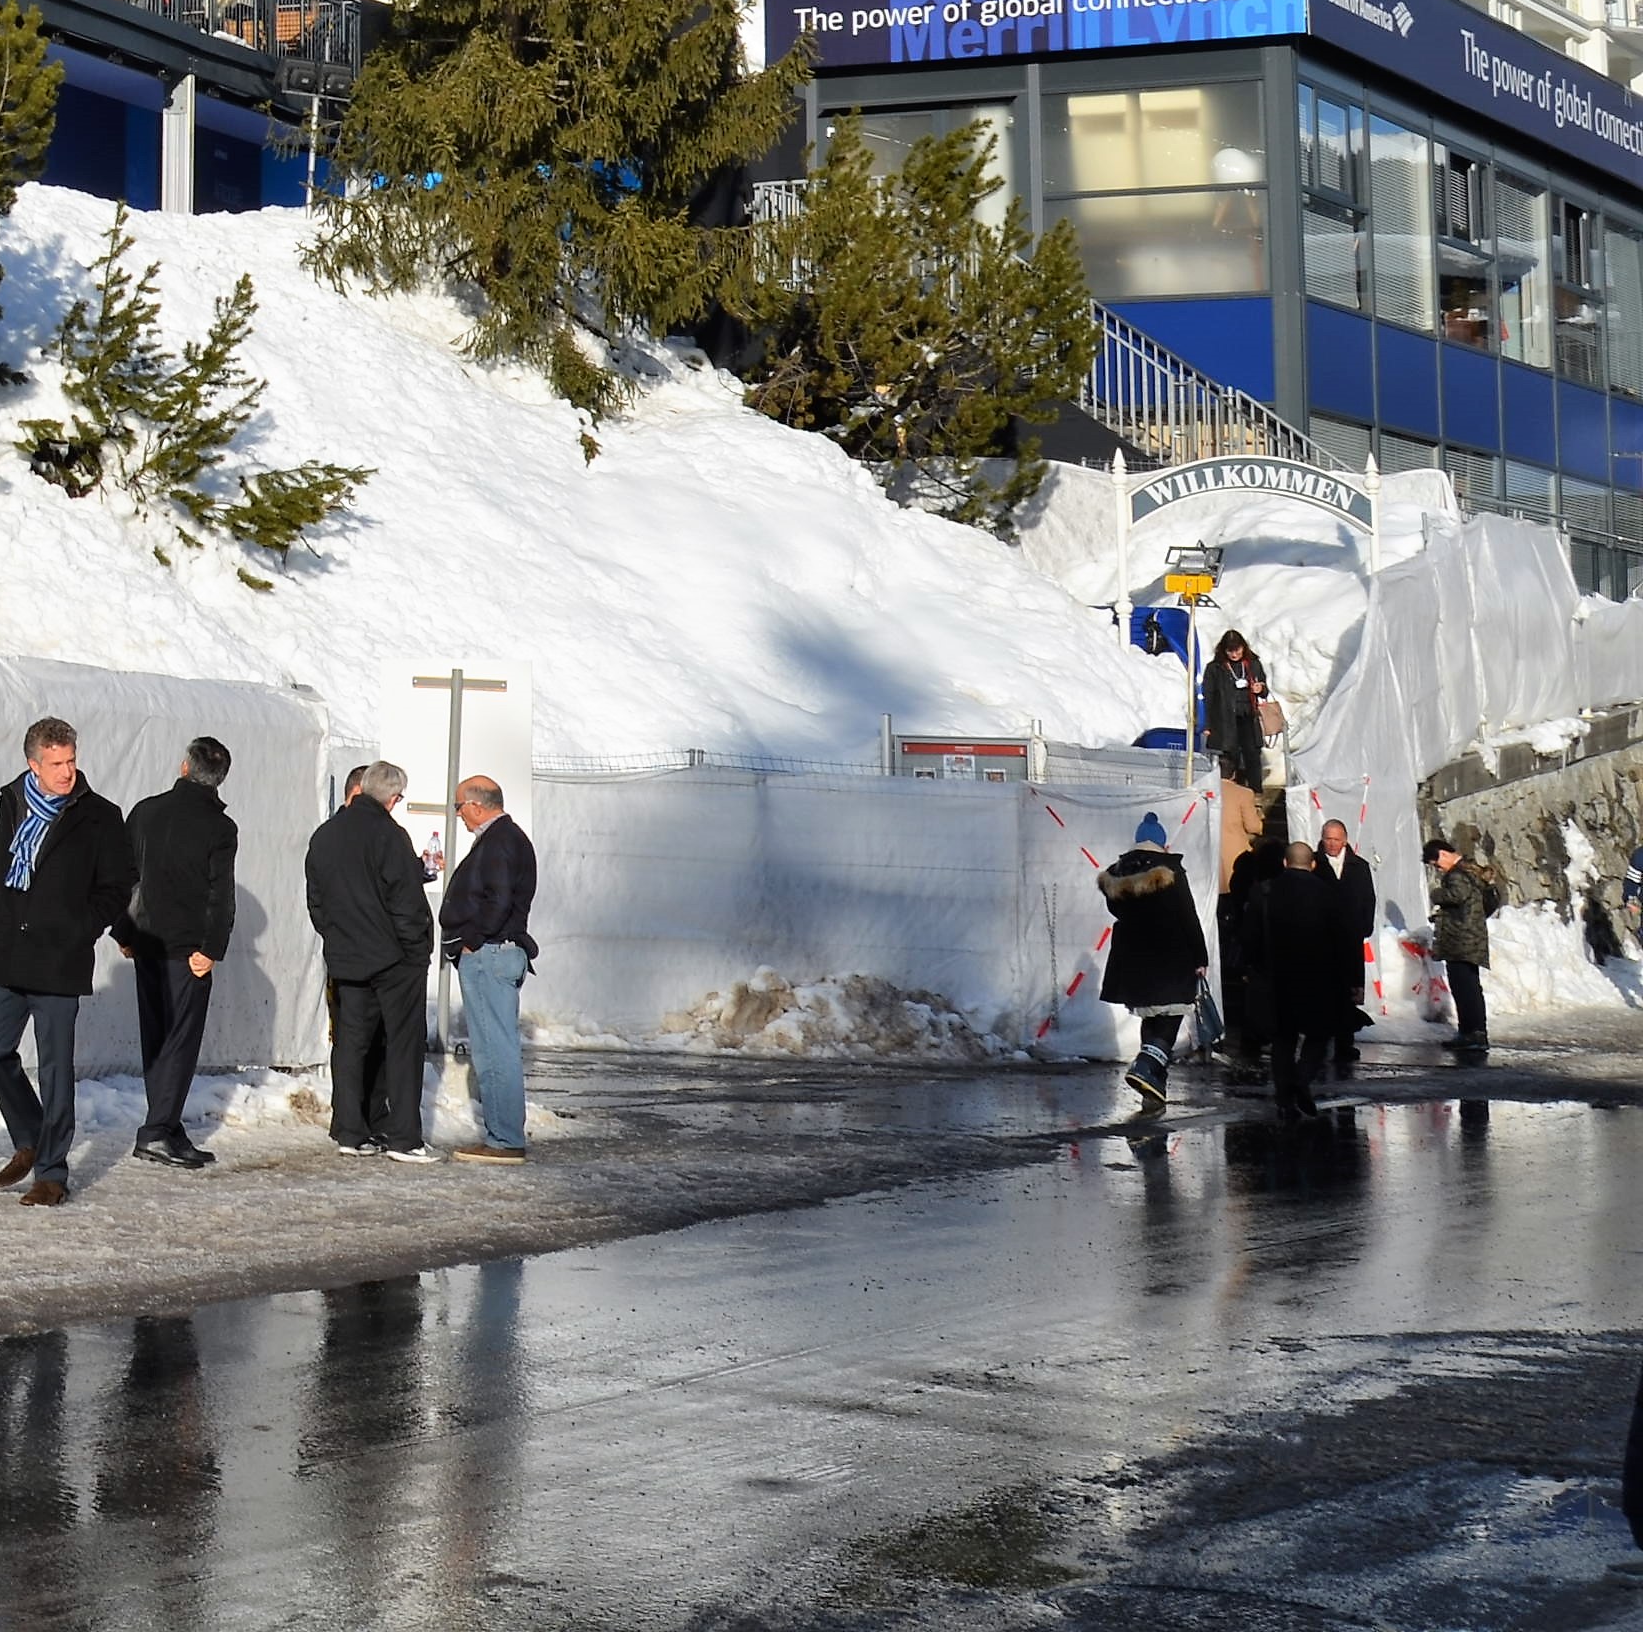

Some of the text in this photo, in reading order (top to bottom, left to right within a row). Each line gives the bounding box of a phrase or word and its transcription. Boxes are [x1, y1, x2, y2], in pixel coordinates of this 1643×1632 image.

[793, 6, 844, 33] The
[852, 3, 935, 36] power
[1460, 29, 1489, 82] The
[1492, 56, 1534, 103] power
[1537, 70, 1552, 111] of
[1554, 78, 1592, 131] global
[1145, 464, 1357, 511] WILLKOMMEN
